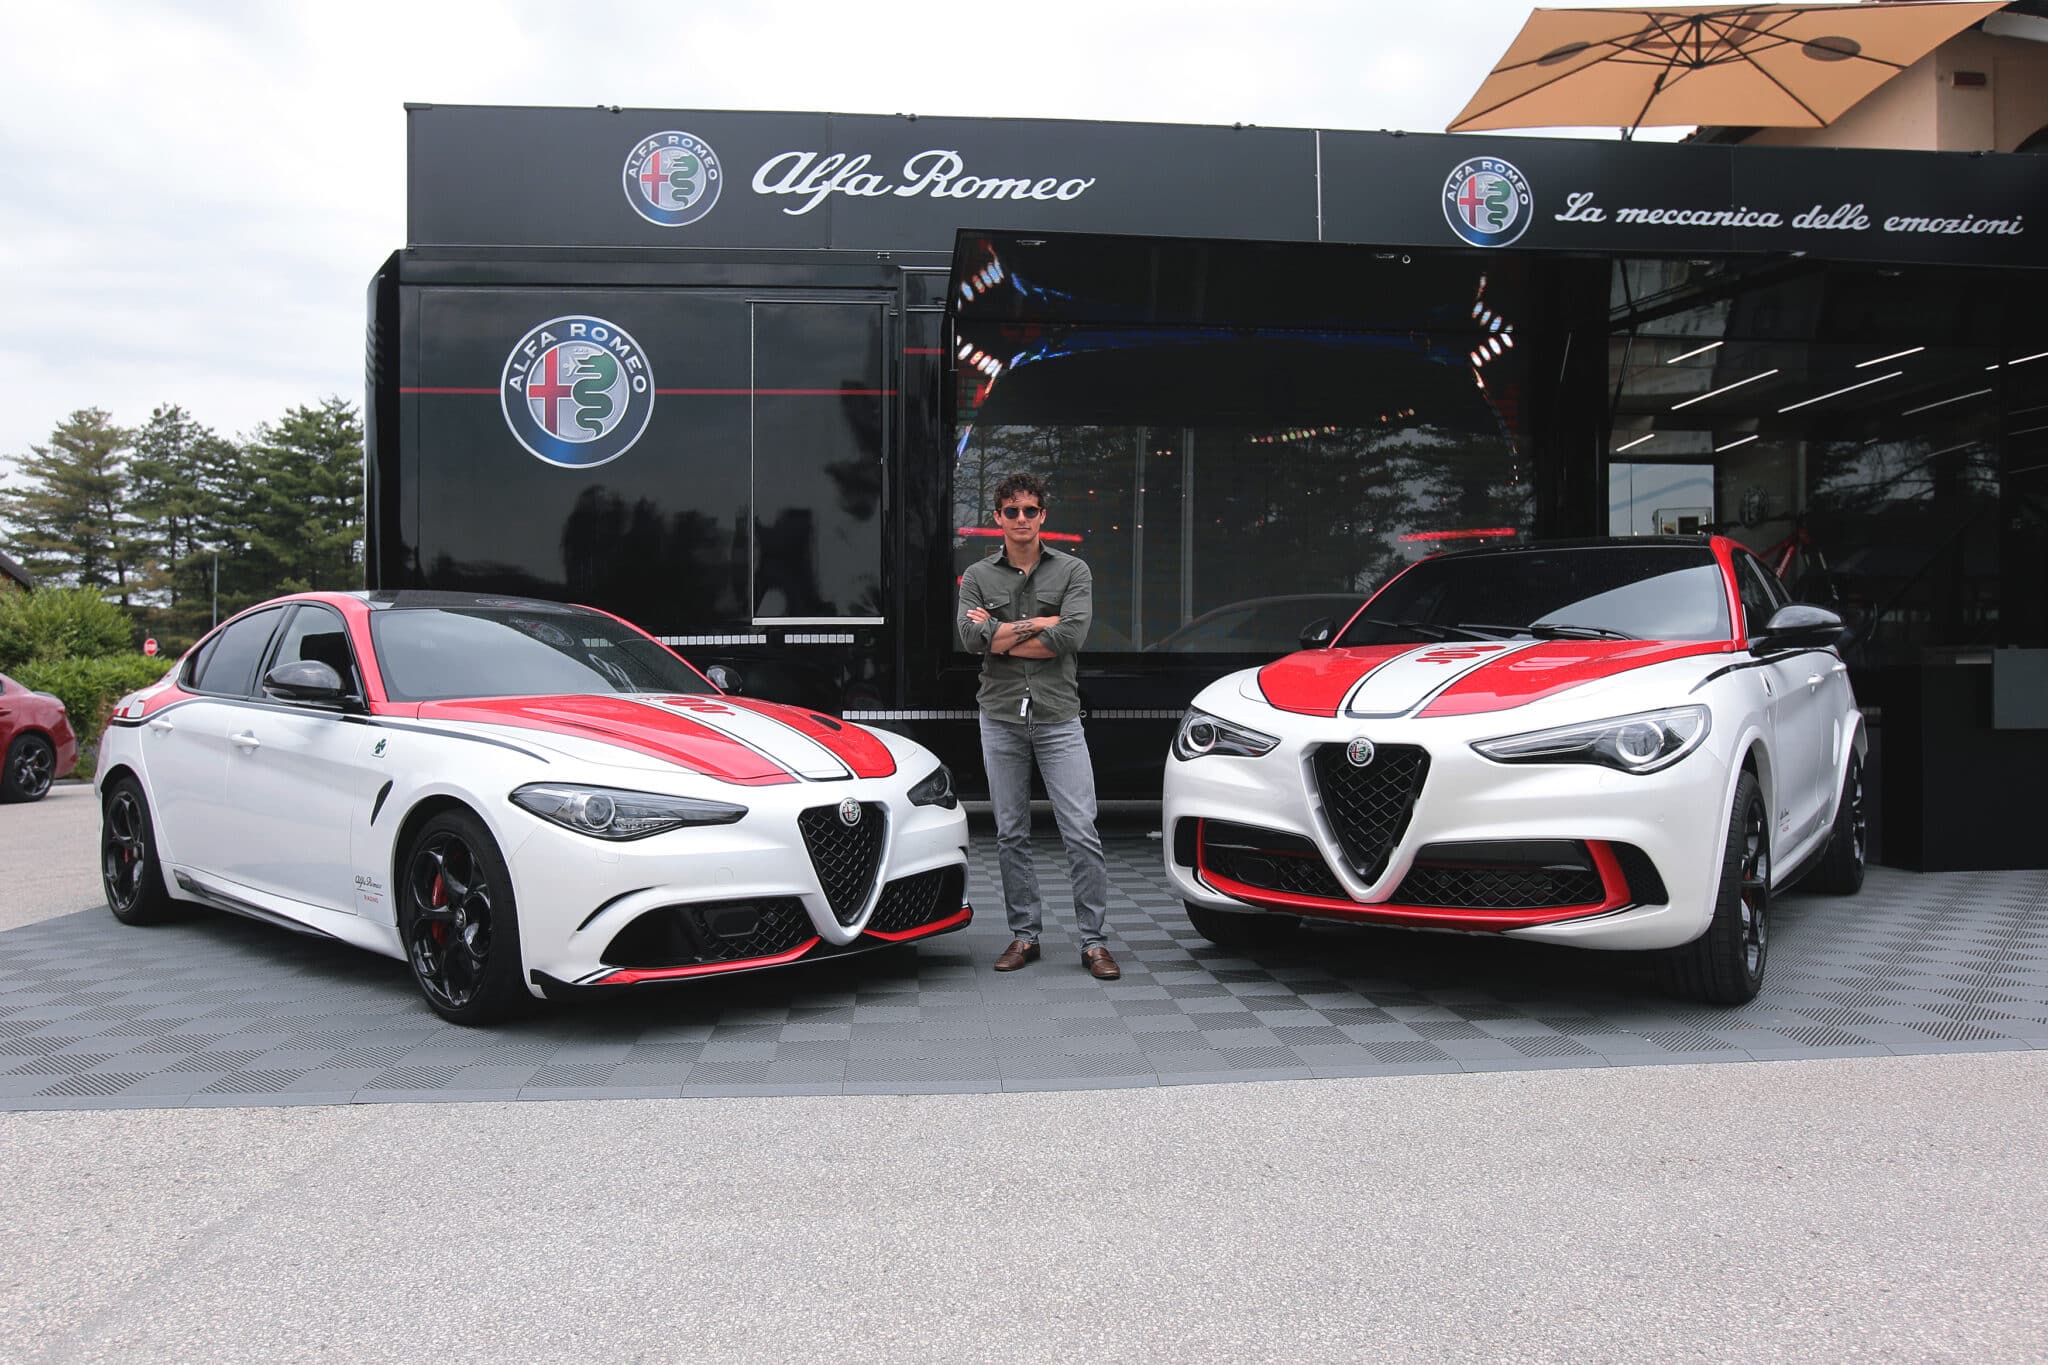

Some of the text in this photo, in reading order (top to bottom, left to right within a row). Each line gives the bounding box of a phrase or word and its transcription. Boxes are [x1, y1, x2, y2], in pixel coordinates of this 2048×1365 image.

[628, 135, 718, 181] ALFA ROMEO
[752, 150, 1096, 215] Alfa Romeo
[1447, 160, 1529, 205] ALFA ROMEO
[1554, 192, 2024, 235] La meccanica delle emozioni
[509, 323, 647, 394] ALFA ROMEO
